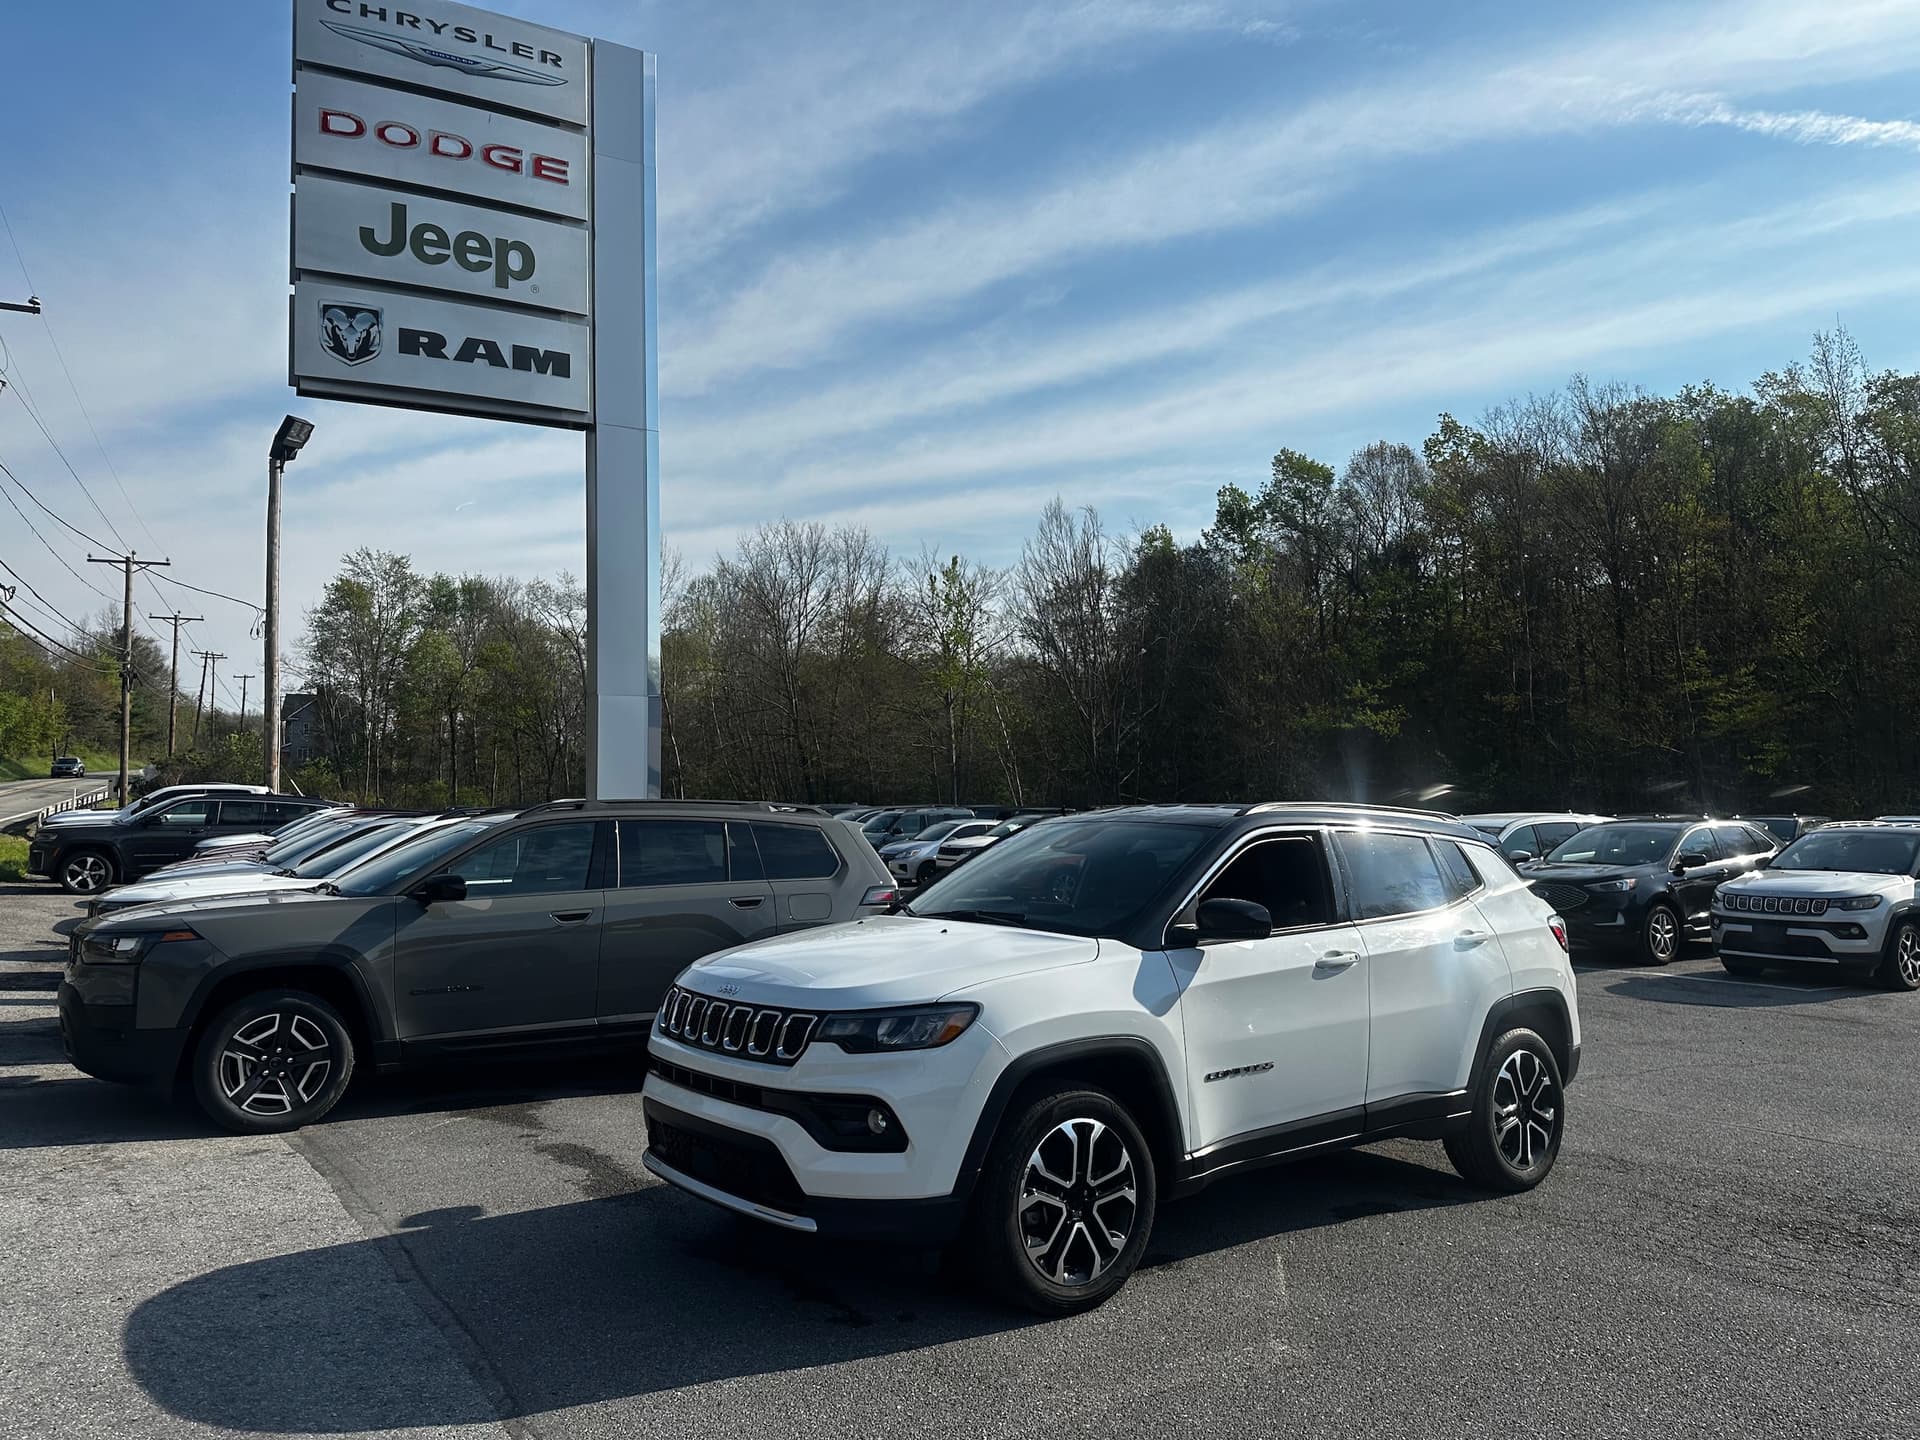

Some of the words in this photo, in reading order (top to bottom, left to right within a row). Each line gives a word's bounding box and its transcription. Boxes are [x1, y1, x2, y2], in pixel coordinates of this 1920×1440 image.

[326, 0, 562, 68] CHRYSLER
[319, 108, 569, 185] DODGE
[359, 202, 536, 290] Jeep
[398, 327, 571, 379] RAM
